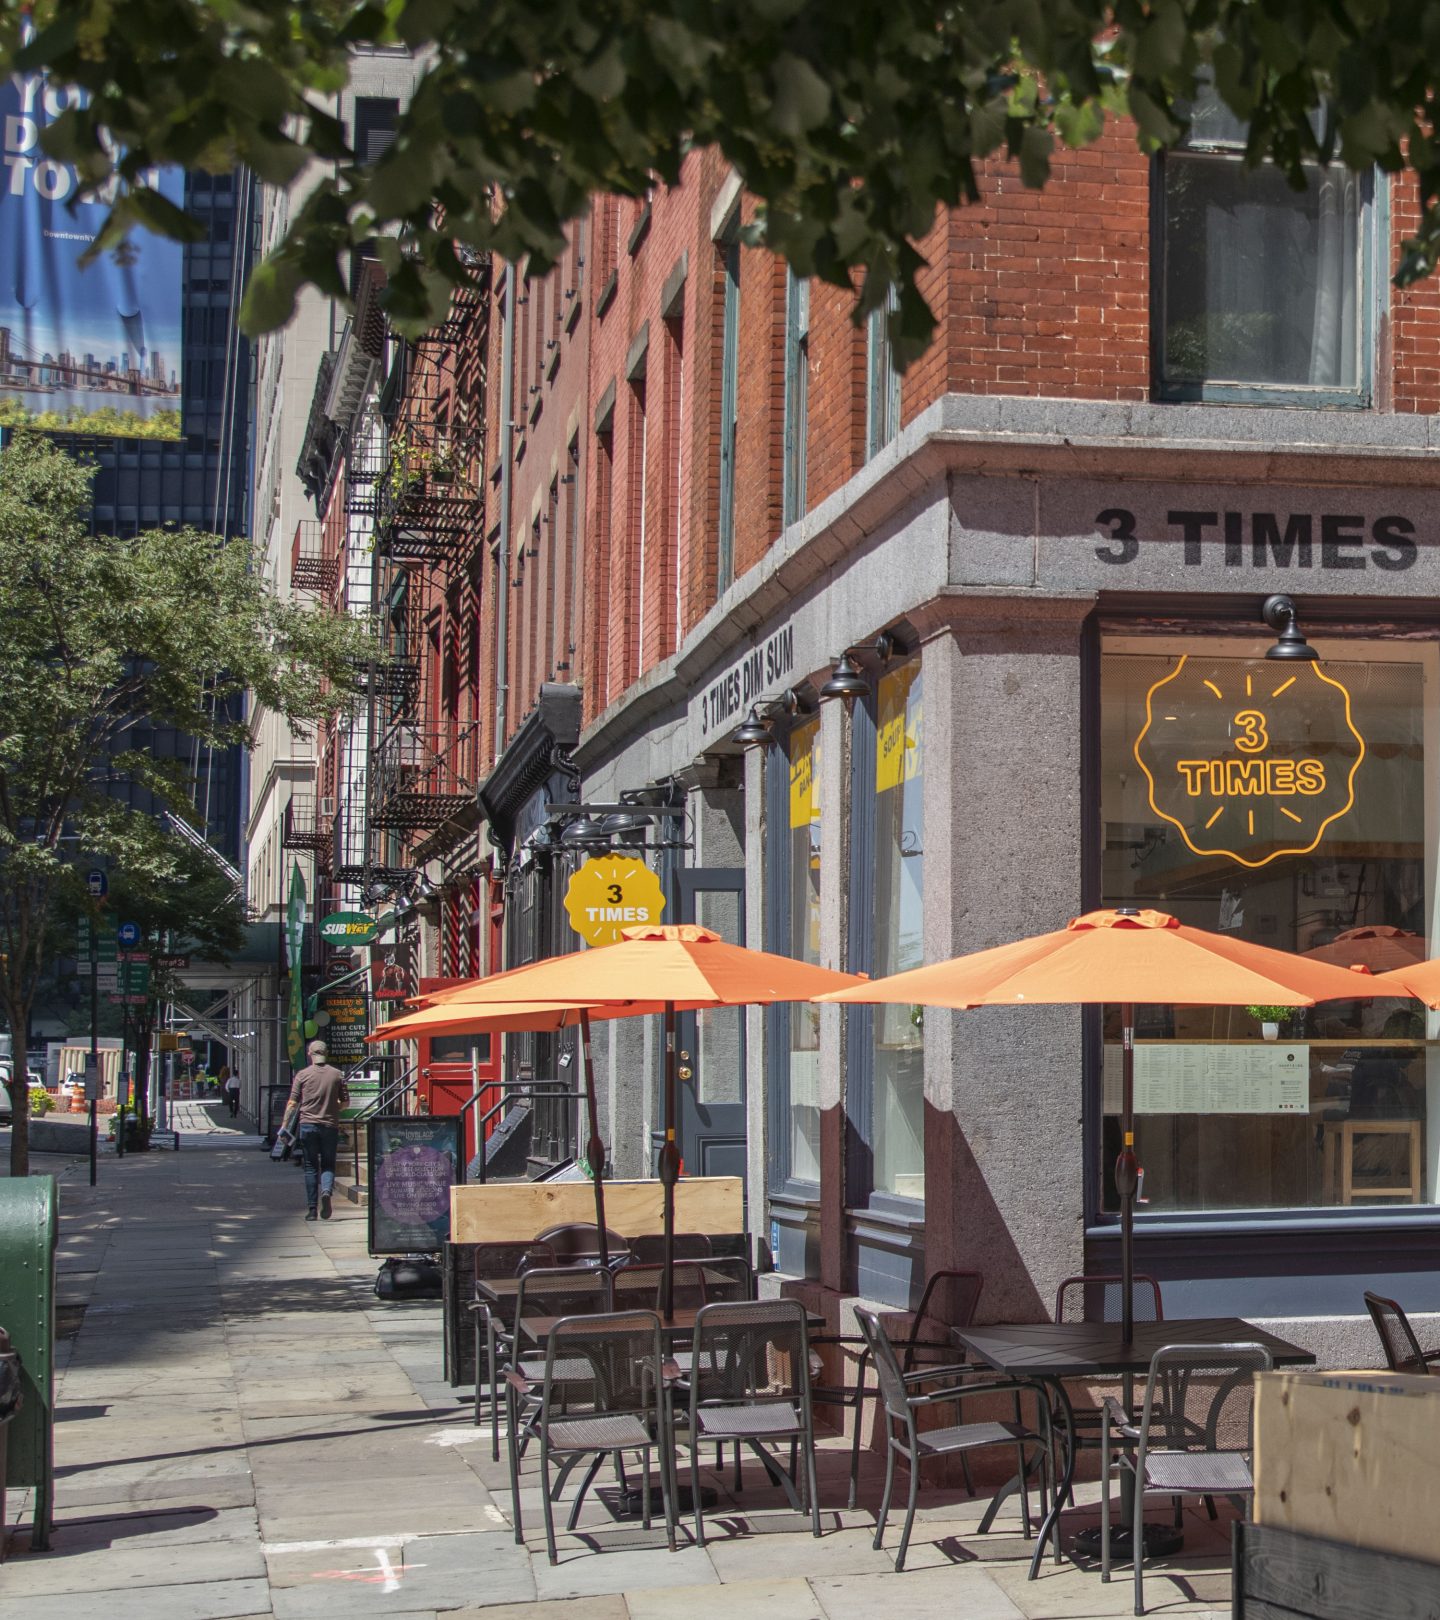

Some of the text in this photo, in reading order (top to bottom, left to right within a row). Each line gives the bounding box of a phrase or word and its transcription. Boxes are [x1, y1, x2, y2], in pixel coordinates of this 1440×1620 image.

[1094, 508, 1140, 566] 3
[1168, 510, 1418, 574] TIMES
[702, 624, 794, 736] 3 TIMES DIM SUM
[1234, 709, 1269, 754] 3
[1177, 760, 1326, 797] TIMES
[607, 884, 623, 904] 3
[321, 923, 374, 935] SUBWAY
[585, 907, 649, 922] TIMES
